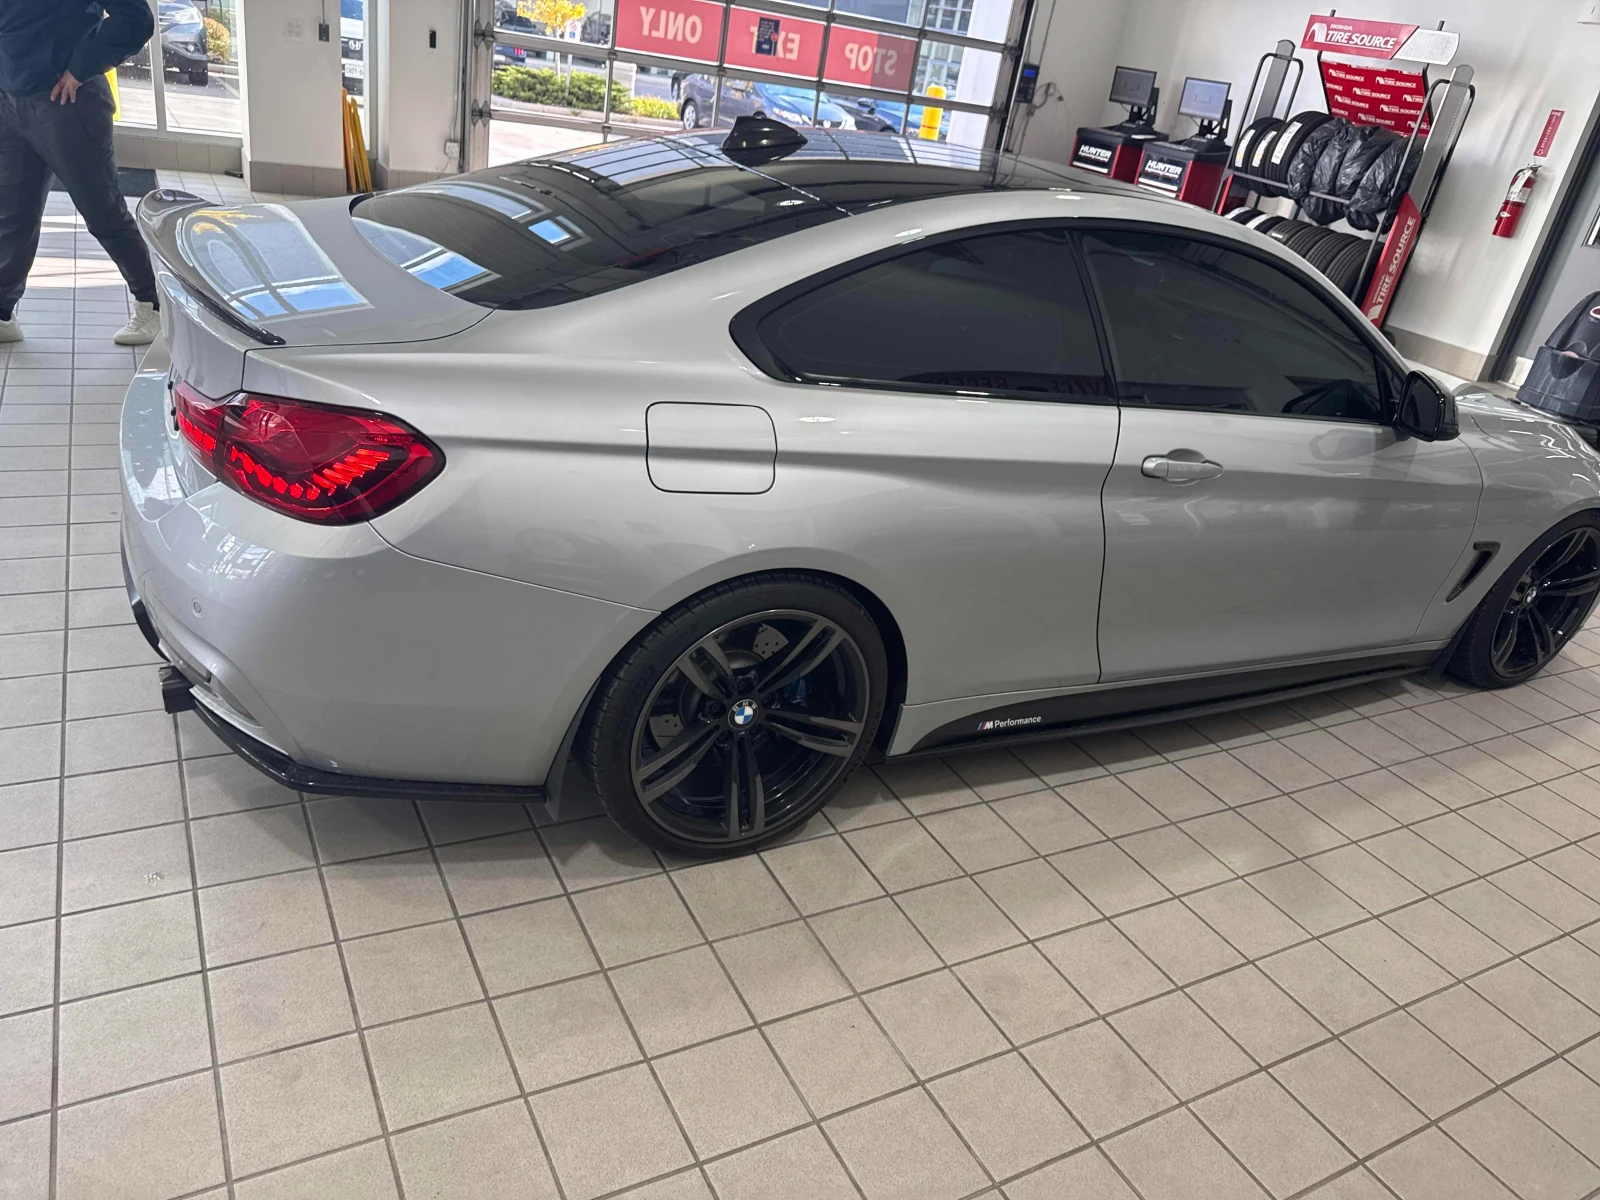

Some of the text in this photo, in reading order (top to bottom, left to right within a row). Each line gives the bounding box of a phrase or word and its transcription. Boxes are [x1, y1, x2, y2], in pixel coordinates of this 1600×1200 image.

[1330, 23, 1353, 31] HONDA
[1326, 30, 1398, 49] TIRE SOURCE
[1079, 144, 1113, 159] HUNTER
[1145, 160, 1183, 175] HUNTER
[1376, 216, 1417, 305] TIRE SOURCE
[732, 701, 758, 711] BMW
[994, 715, 1042, 729] Performance
